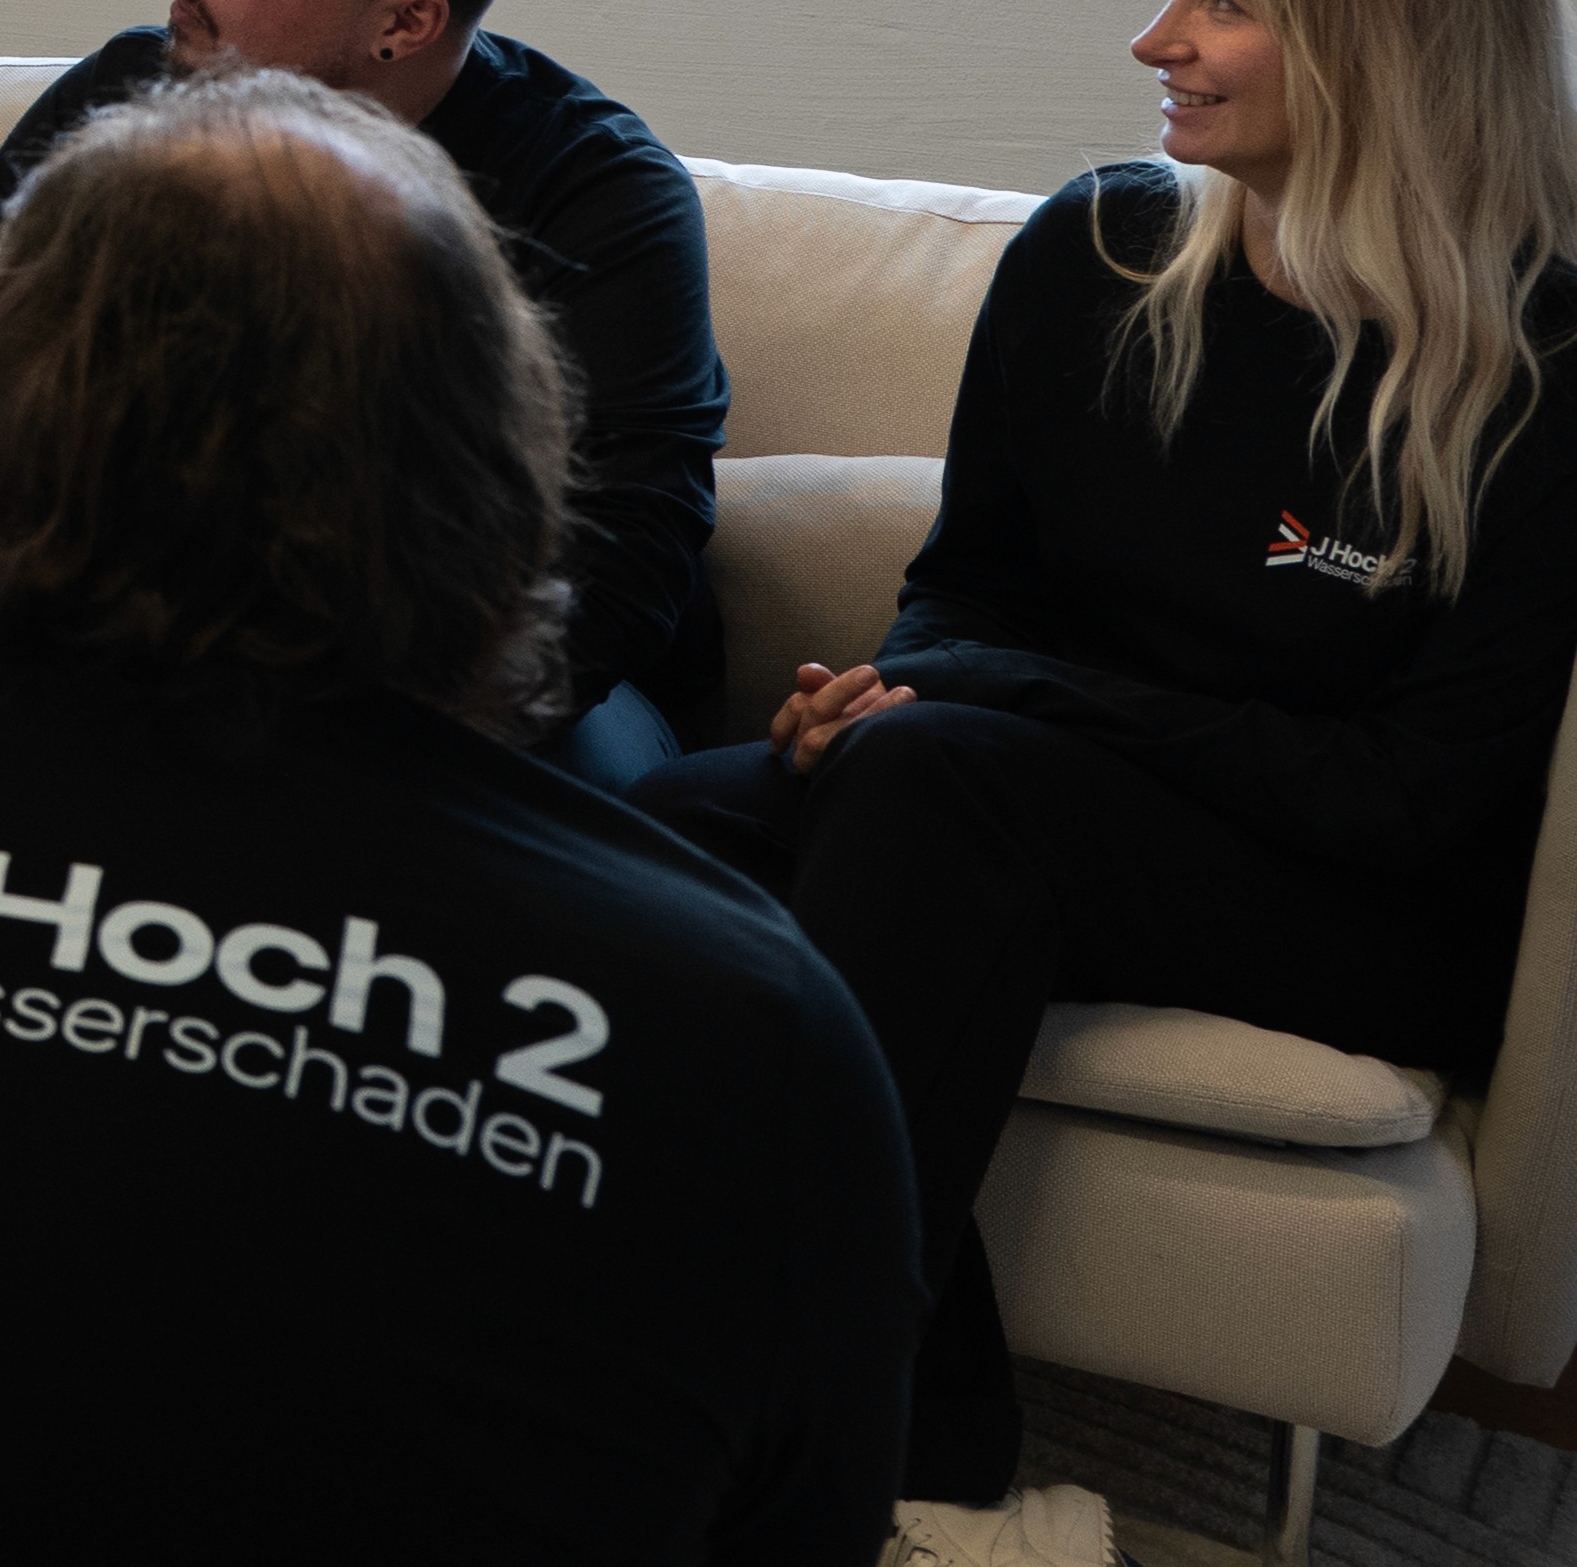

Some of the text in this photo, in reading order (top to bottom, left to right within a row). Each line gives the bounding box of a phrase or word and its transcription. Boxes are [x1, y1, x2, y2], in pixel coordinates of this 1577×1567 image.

[1310, 537, 1330, 556] J
[1399, 558, 1418, 575] 2
[495, 975, 609, 1116] 2
